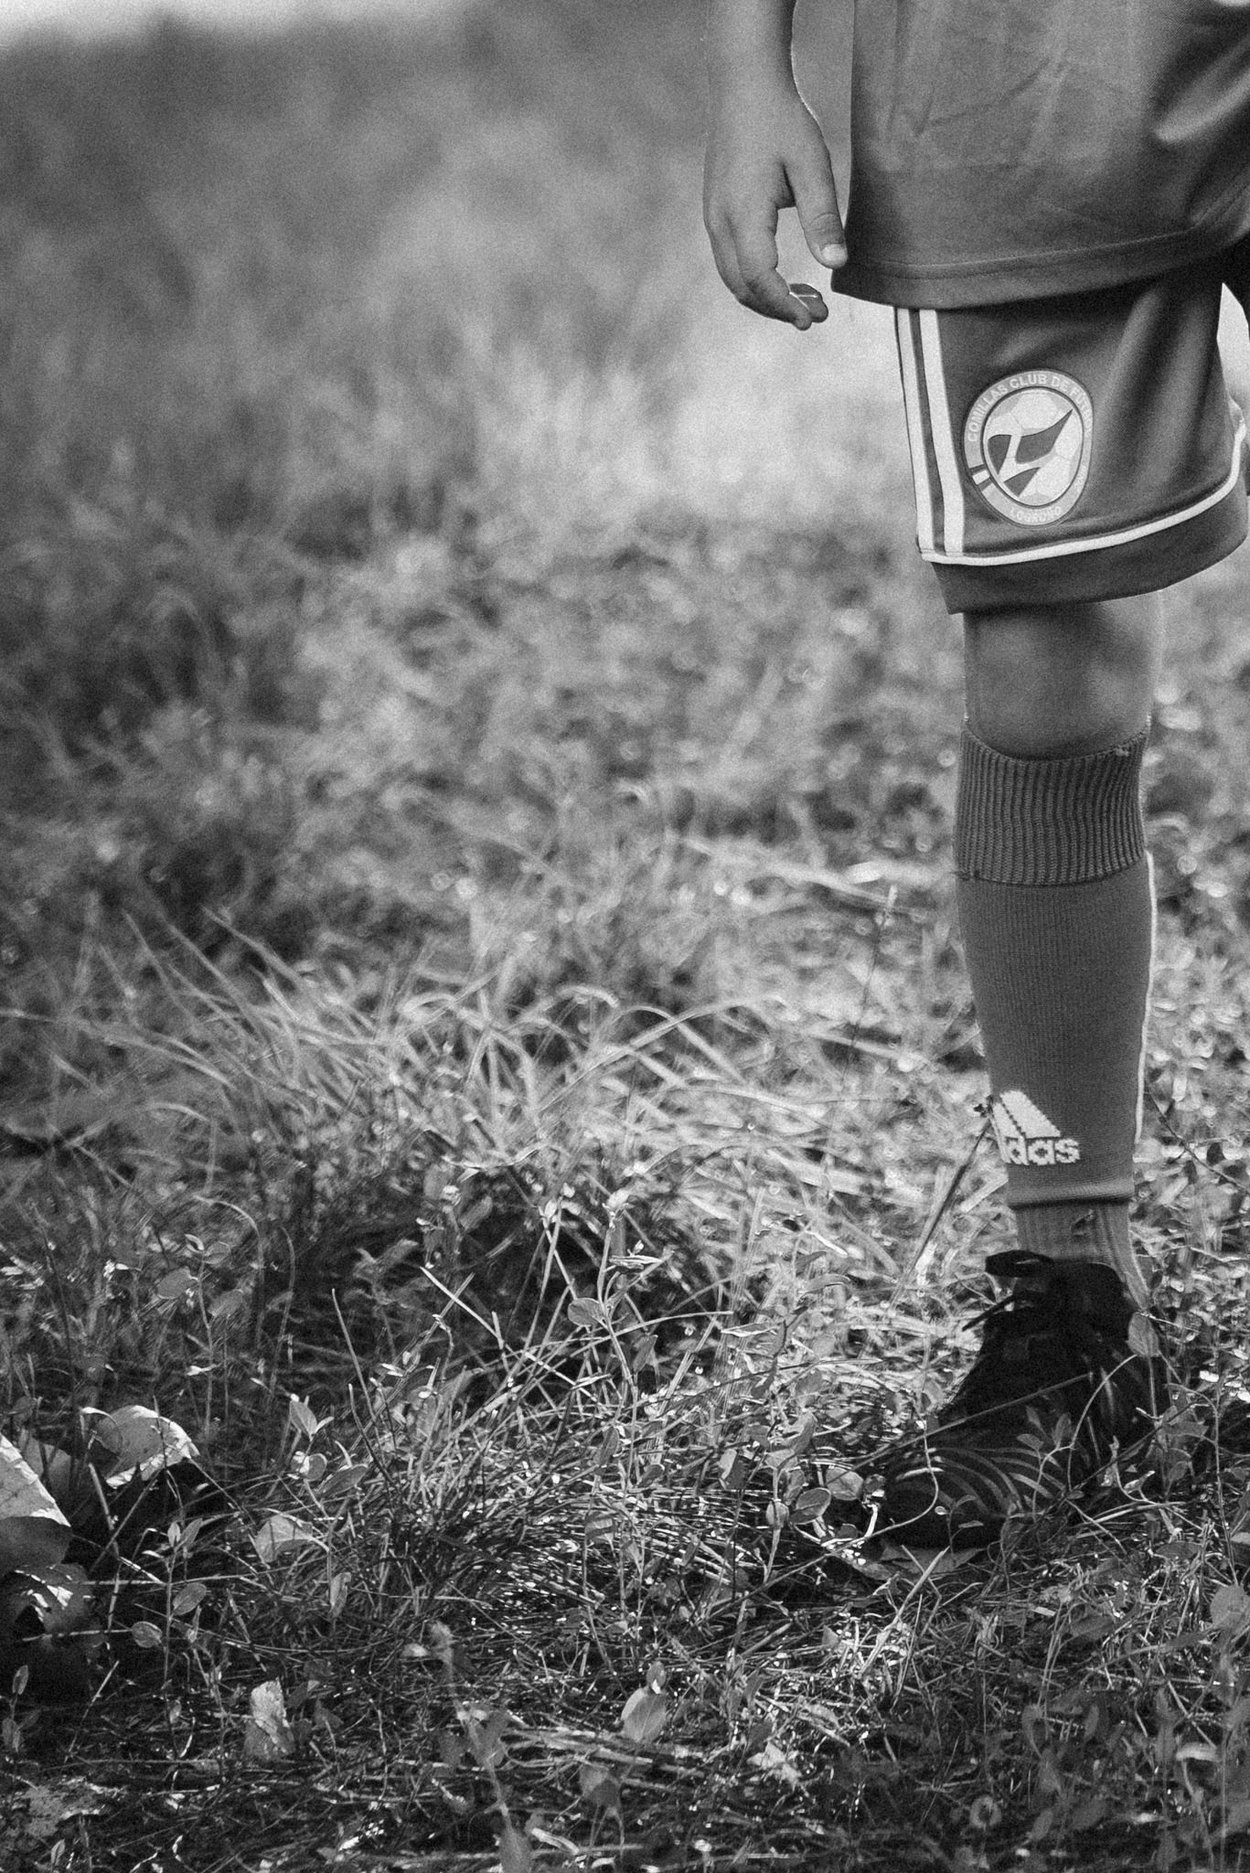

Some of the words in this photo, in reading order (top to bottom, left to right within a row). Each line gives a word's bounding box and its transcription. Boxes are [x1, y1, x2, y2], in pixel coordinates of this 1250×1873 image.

[967, 384, 1008, 442] COMILLAS
[1009, 374, 1047, 388] CLUB
[1051, 376, 1069, 392] DE
